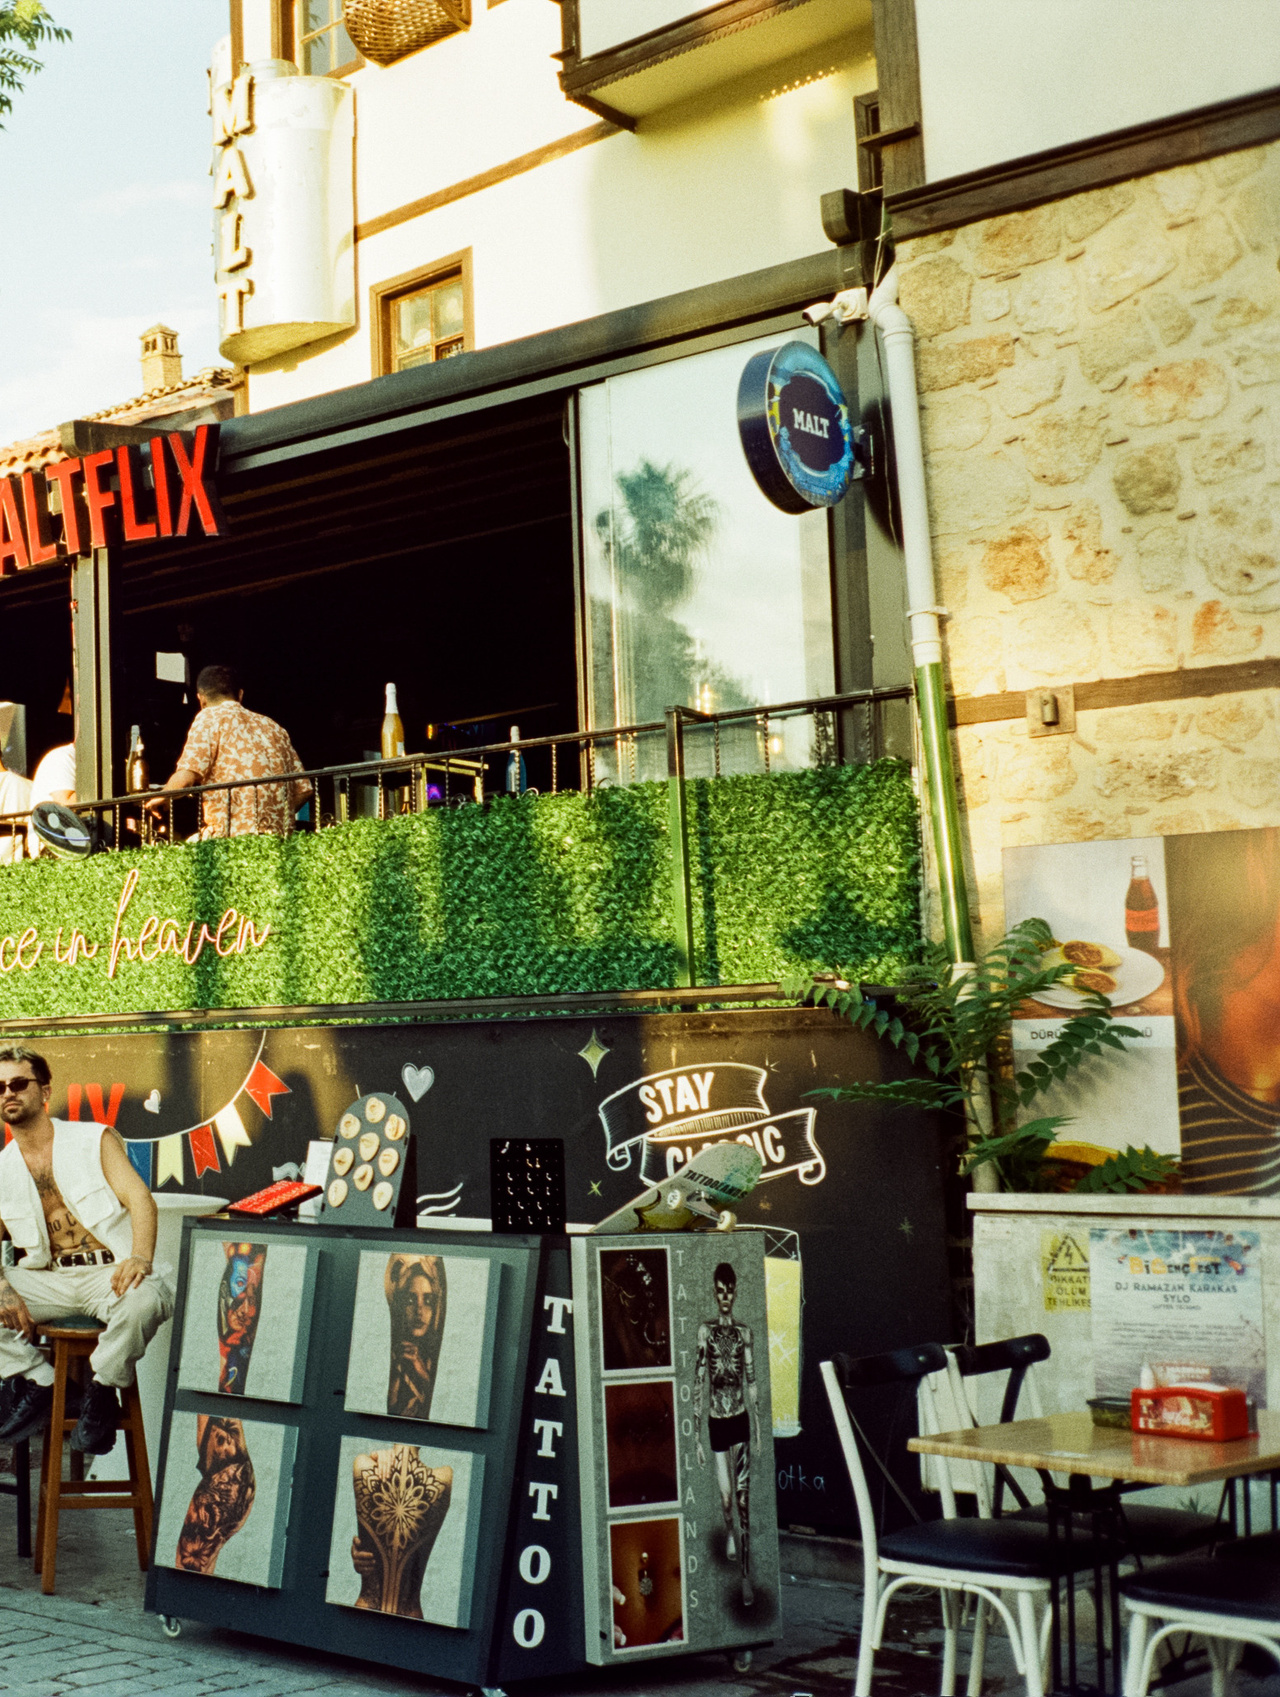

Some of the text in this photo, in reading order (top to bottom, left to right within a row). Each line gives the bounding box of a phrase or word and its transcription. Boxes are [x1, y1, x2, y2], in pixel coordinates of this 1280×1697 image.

[211, 74, 254, 336] MALT
[793, 408, 830, 439] MALT
[54, 925, 98, 966] in
[107, 869, 271, 978] heaven
[638, 1071, 715, 1124] STAY
[512, 1294, 573, 1649] TATTOO
[675, 1249, 699, 1609] TATTOOLANDS
